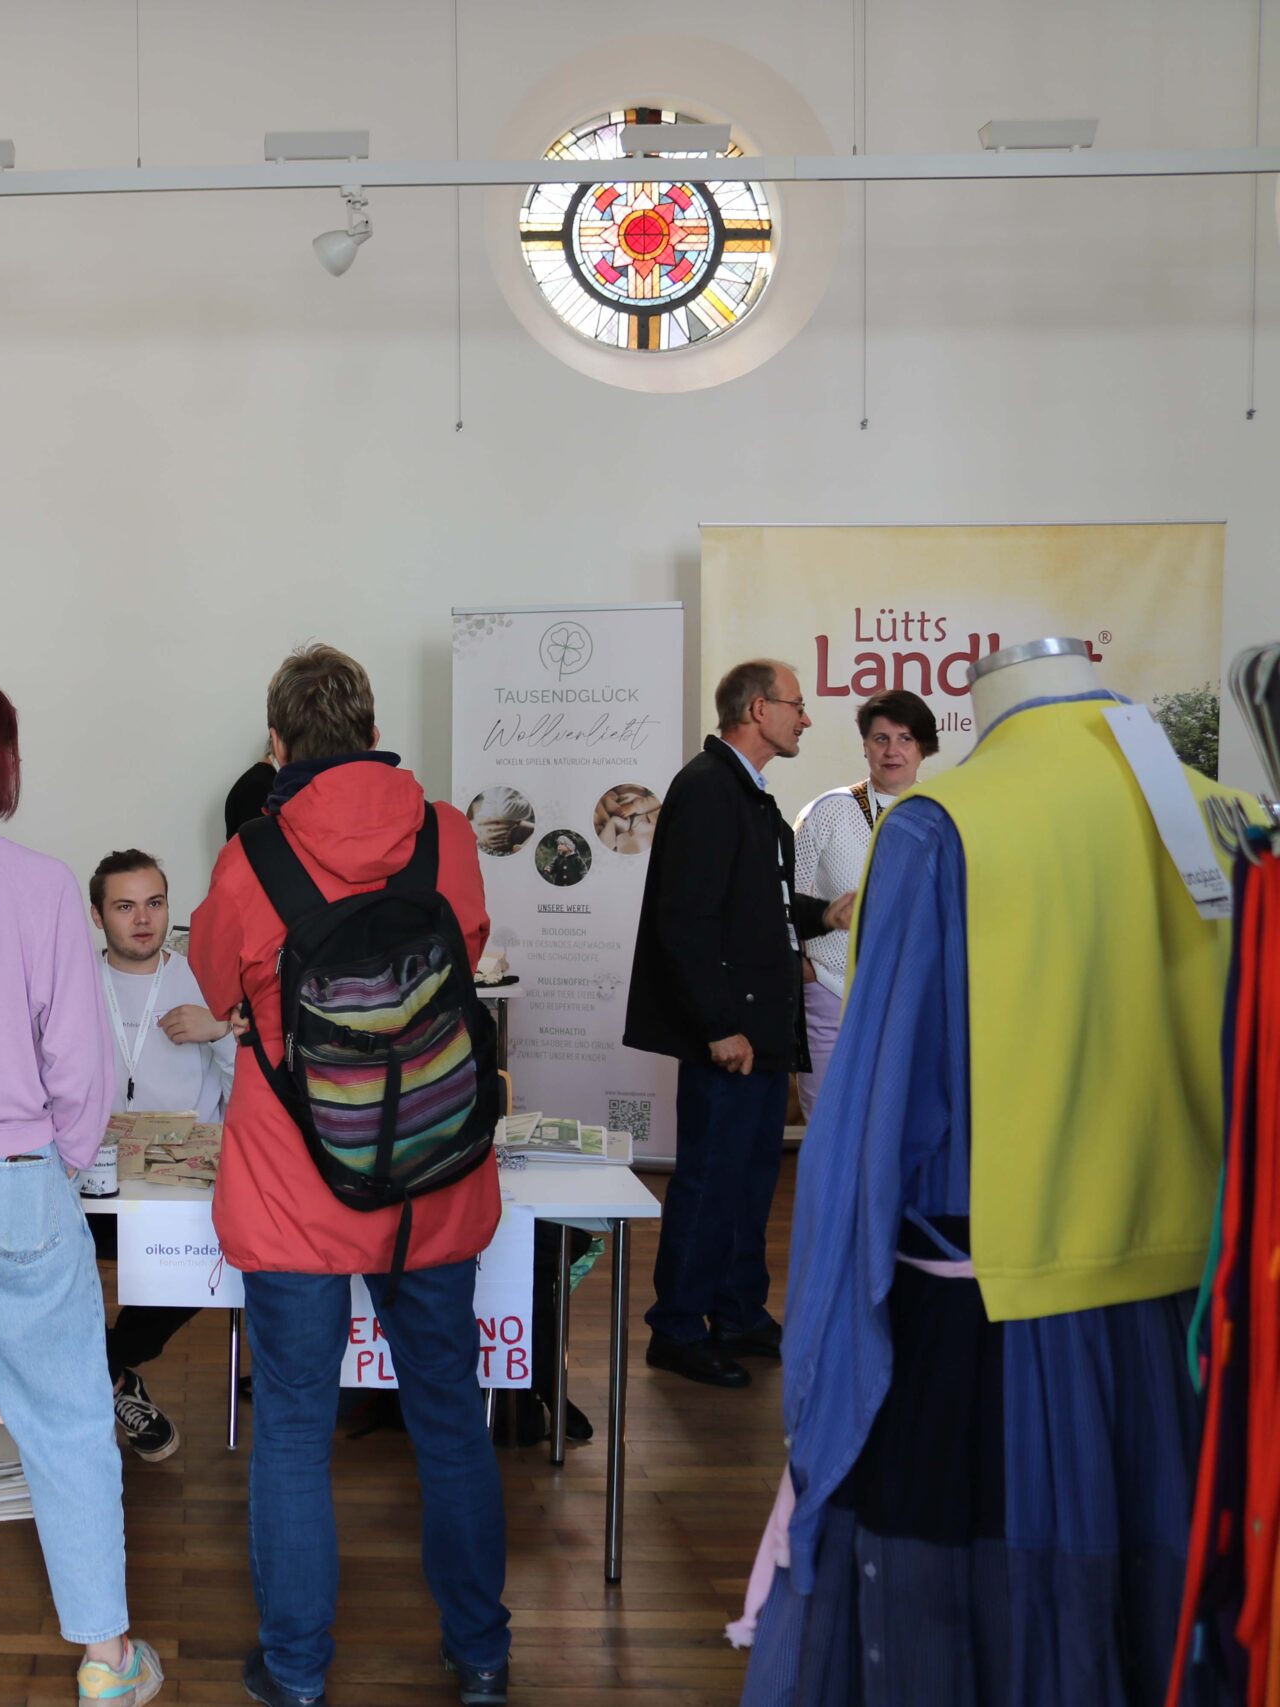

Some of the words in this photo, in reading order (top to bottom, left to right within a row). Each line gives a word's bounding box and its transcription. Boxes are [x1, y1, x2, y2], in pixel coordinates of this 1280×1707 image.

[854, 607, 947, 642] Lütts
[494, 685, 639, 704] TAUSENDGLÜCK
[936, 712, 972, 732] ulle
[483, 713, 661, 751] Wollverliebt
[537, 904, 565, 913] UNSERE
[541, 928, 587, 937] BIOLOGISCH
[145, 1243, 181, 1255] oikos
[506, 1347, 529, 1381] B
